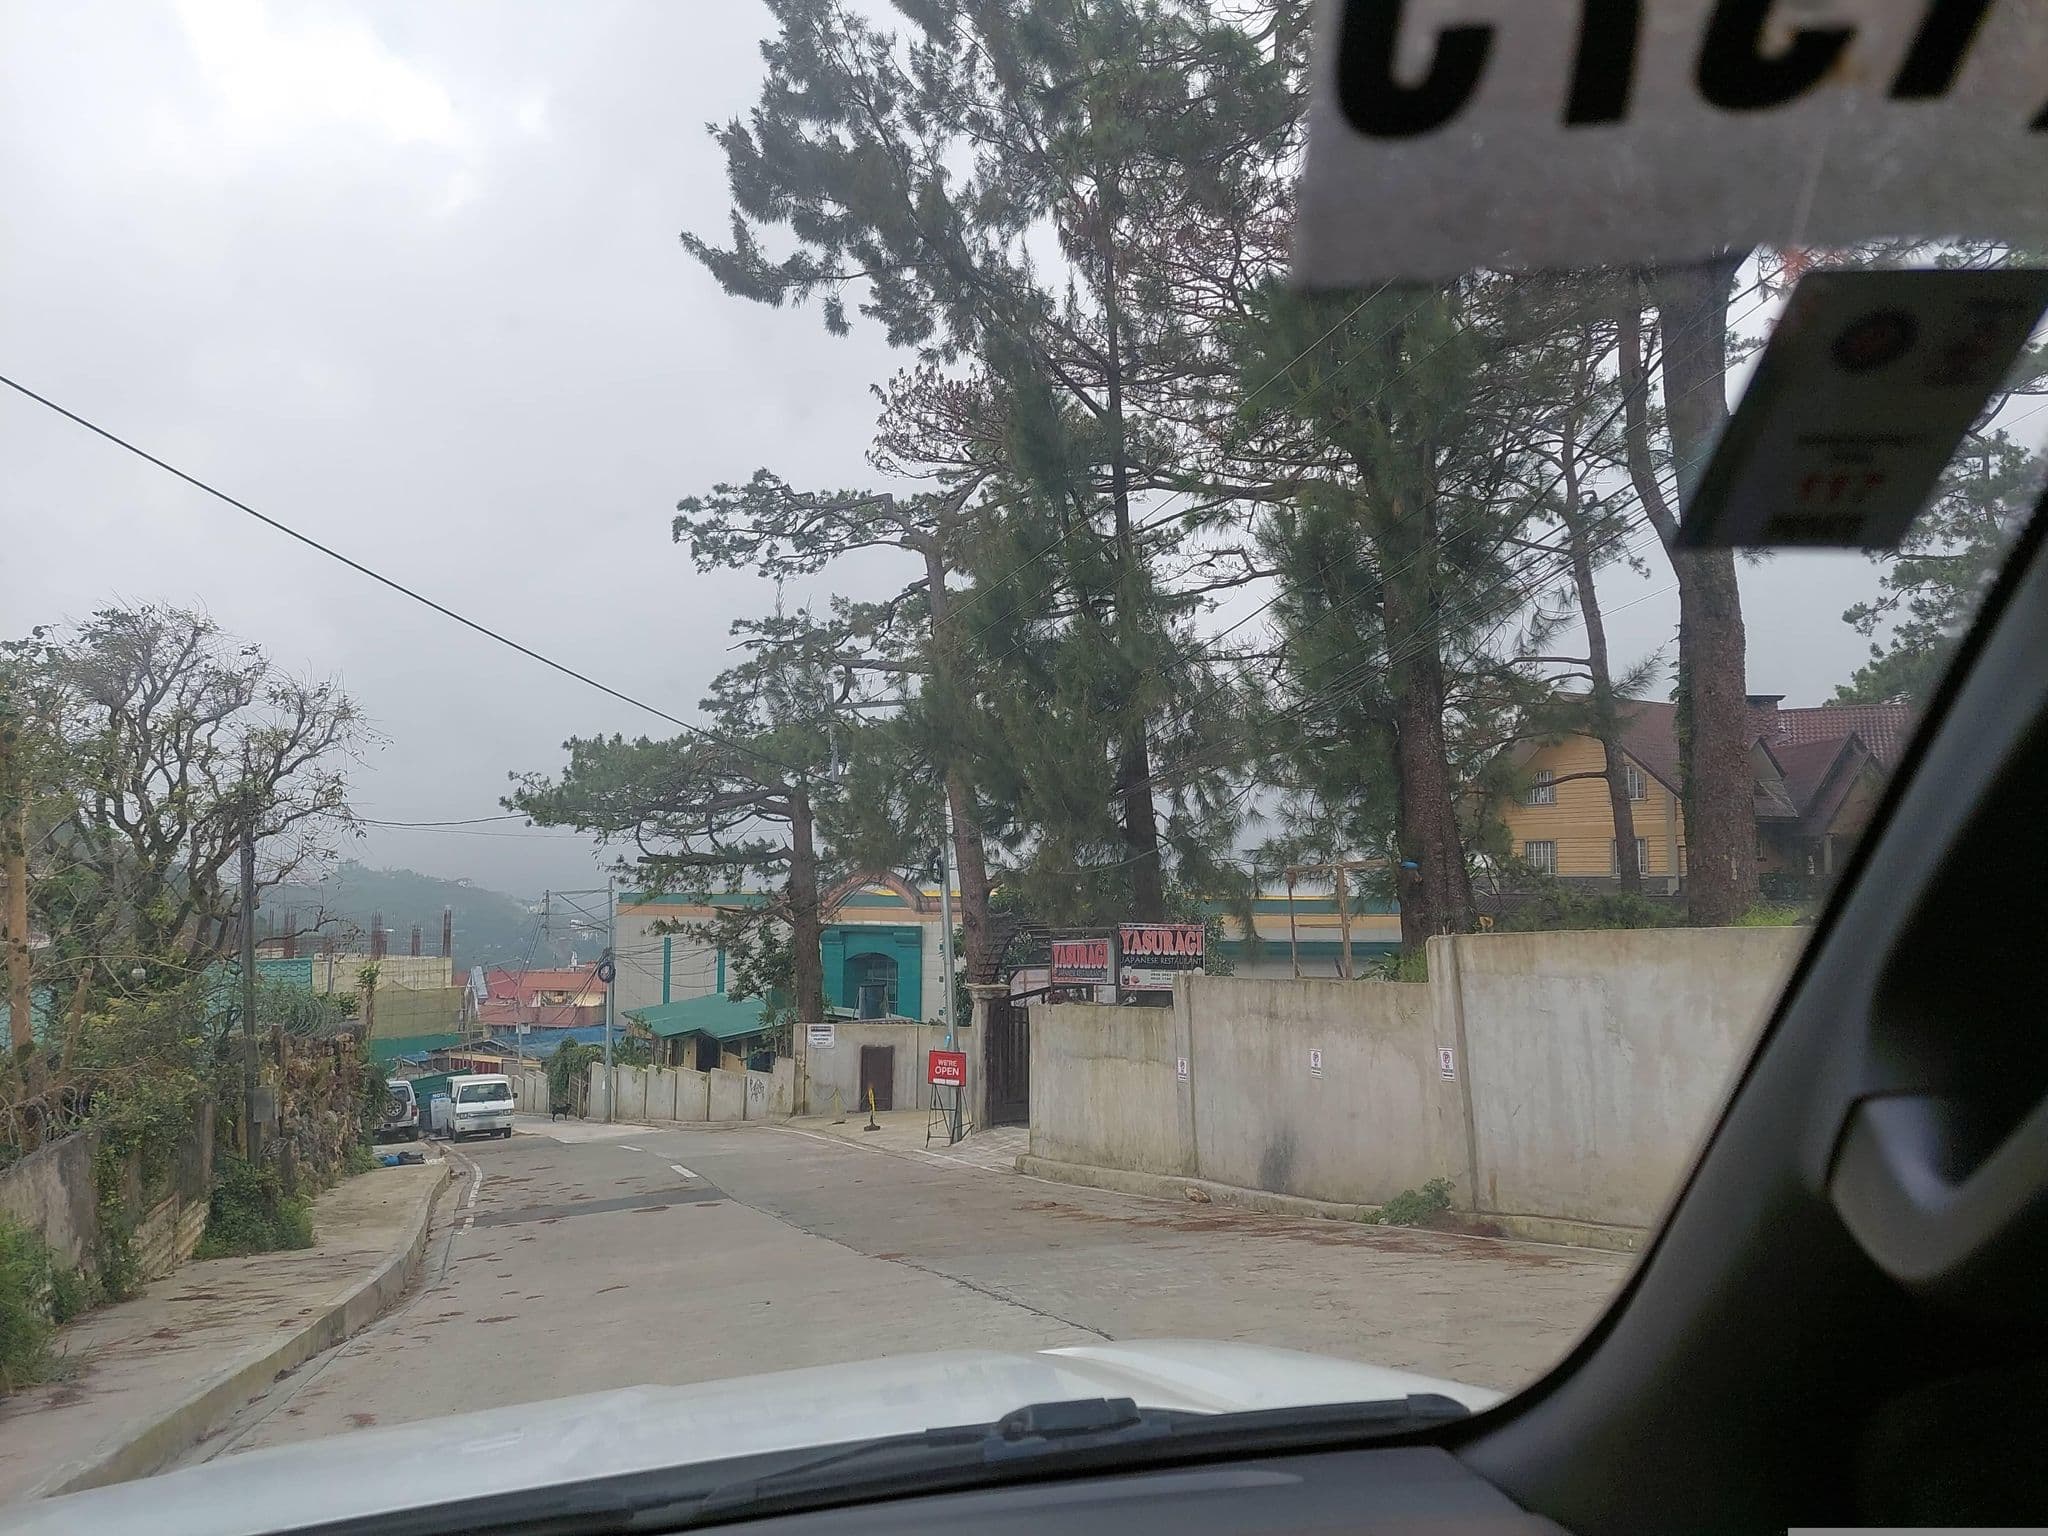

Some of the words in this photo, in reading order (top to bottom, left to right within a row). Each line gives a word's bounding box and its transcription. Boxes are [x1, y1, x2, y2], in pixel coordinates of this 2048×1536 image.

[1119, 930, 1203, 956] YASURAGI
[1053, 944, 1109, 969] YASURAGI
[1120, 956, 1159, 964] JAPANESE
[937, 1059, 957, 1067] WE'RE
[935, 1066, 959, 1076] OPEN
